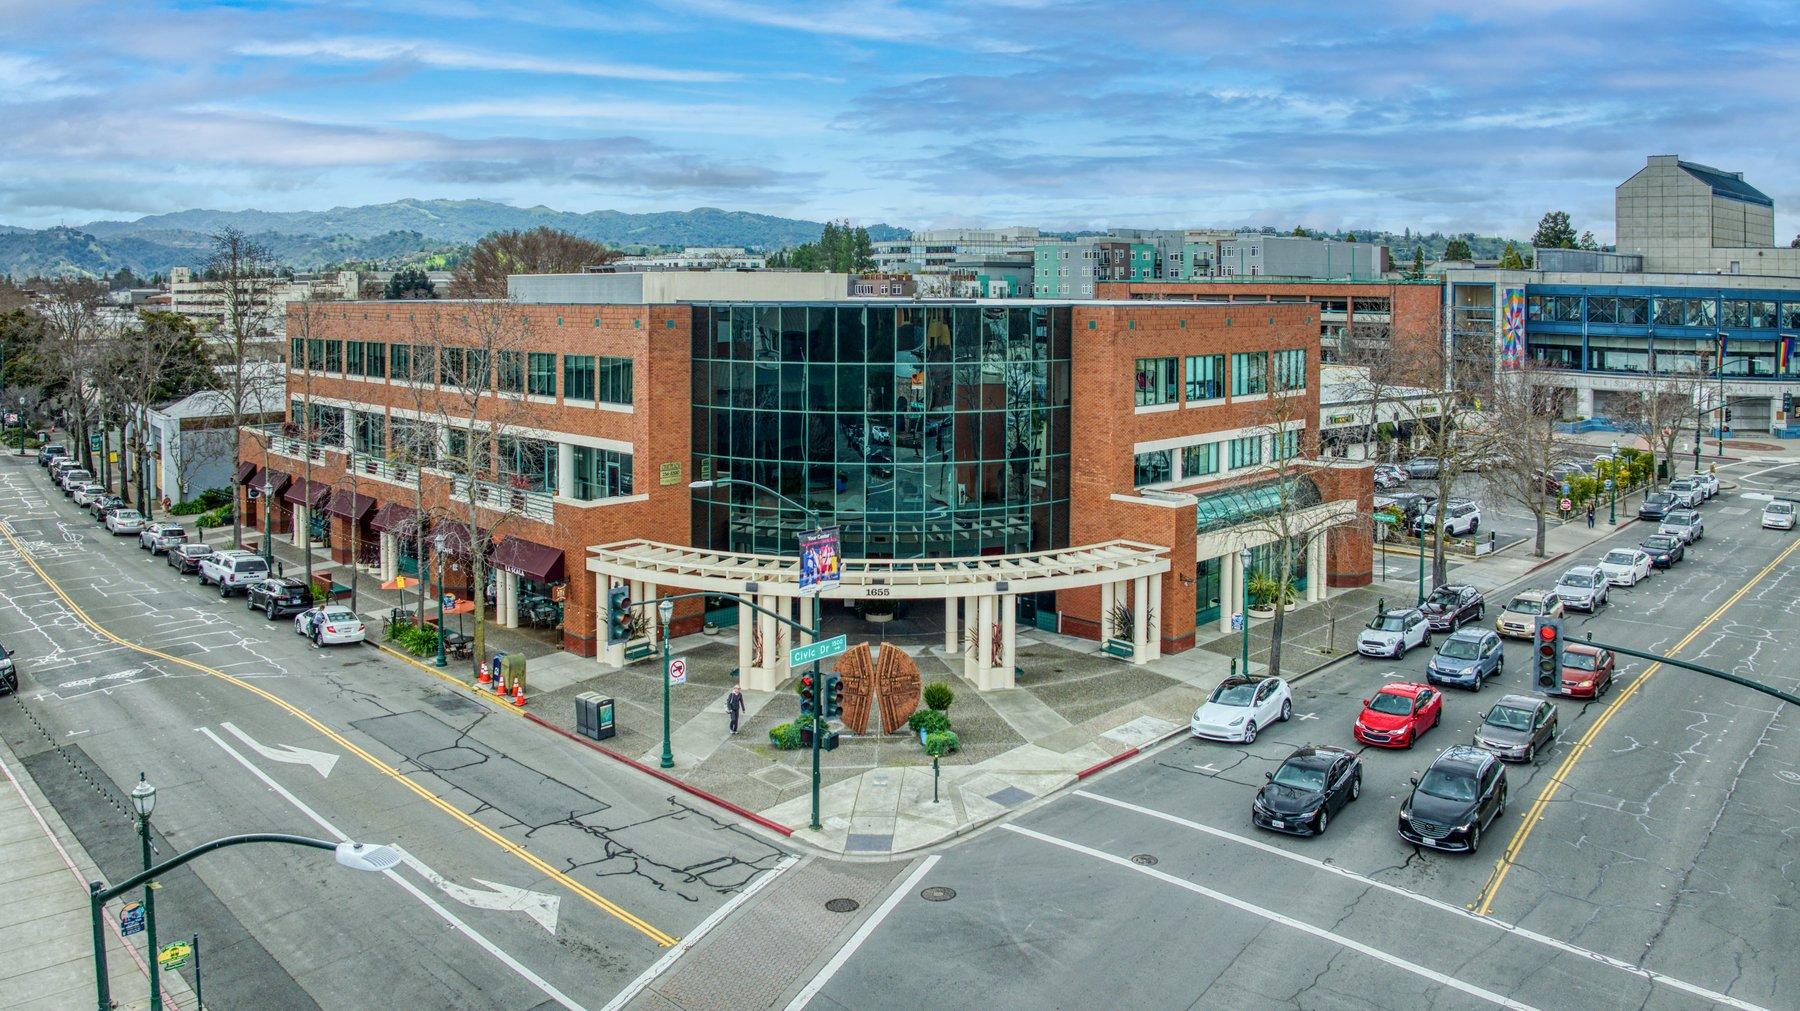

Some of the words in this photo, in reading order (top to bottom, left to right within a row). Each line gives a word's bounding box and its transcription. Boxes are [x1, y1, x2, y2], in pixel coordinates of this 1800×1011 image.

[866, 588, 890, 596] 1655
[794, 648, 815, 662] Civic
[820, 645, 830, 654] Dr
